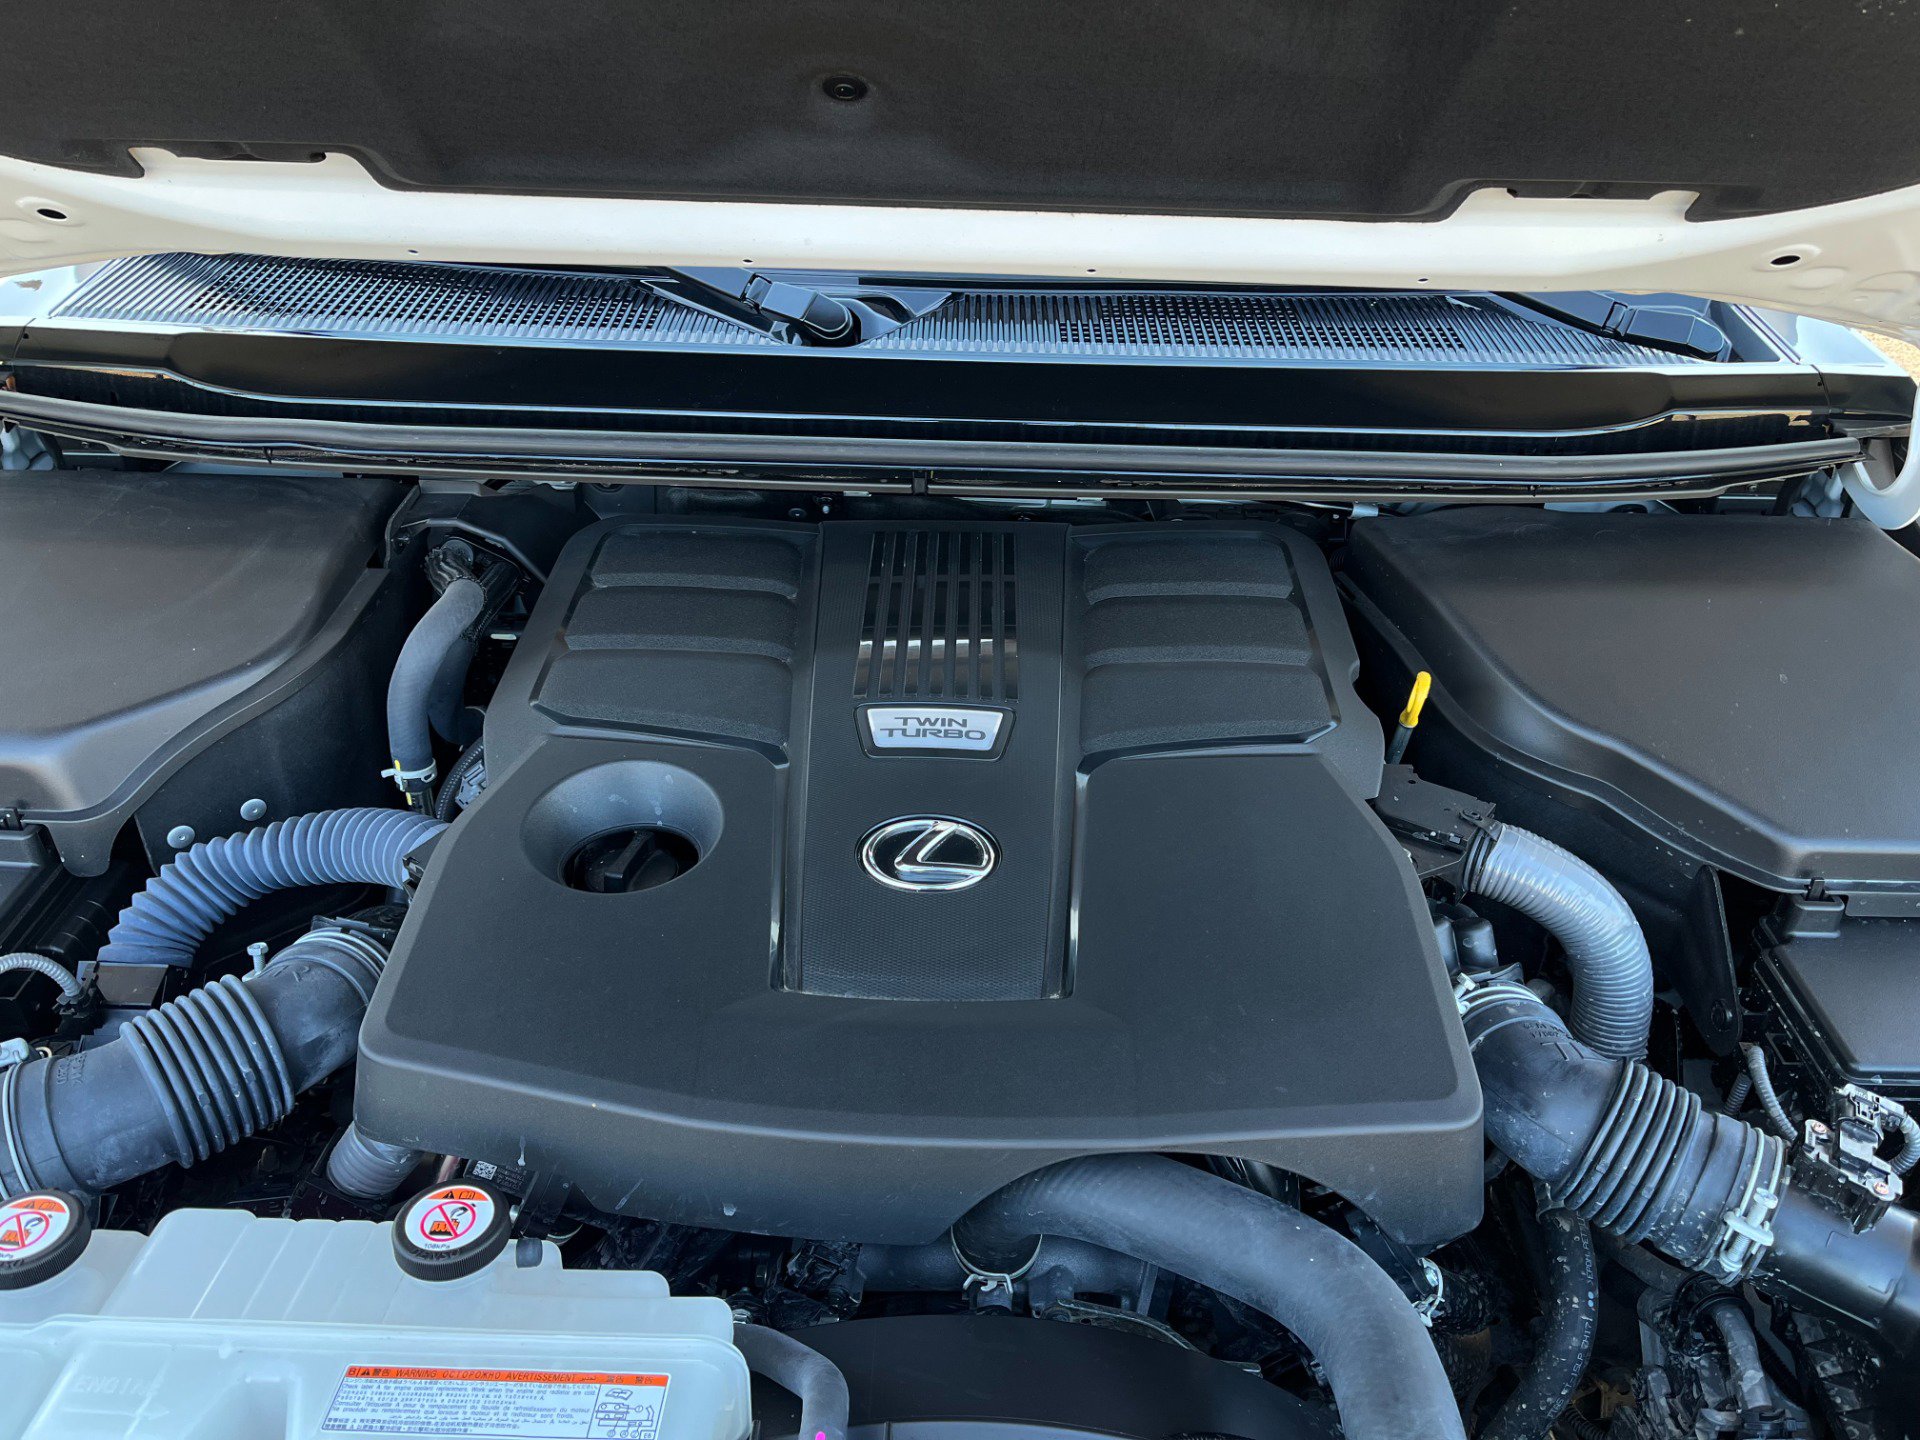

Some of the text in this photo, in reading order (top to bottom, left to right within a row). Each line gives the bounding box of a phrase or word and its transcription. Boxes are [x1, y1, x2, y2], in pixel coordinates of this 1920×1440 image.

[894, 716, 968, 728] TWIN
[880, 728, 987, 741] TURBO
[396, 1369, 438, 1379] WARNING
[442, 1370, 501, 1380] ОСТОРОЖНО
[504, 1372, 577, 1382] AVERTISSEMENT
